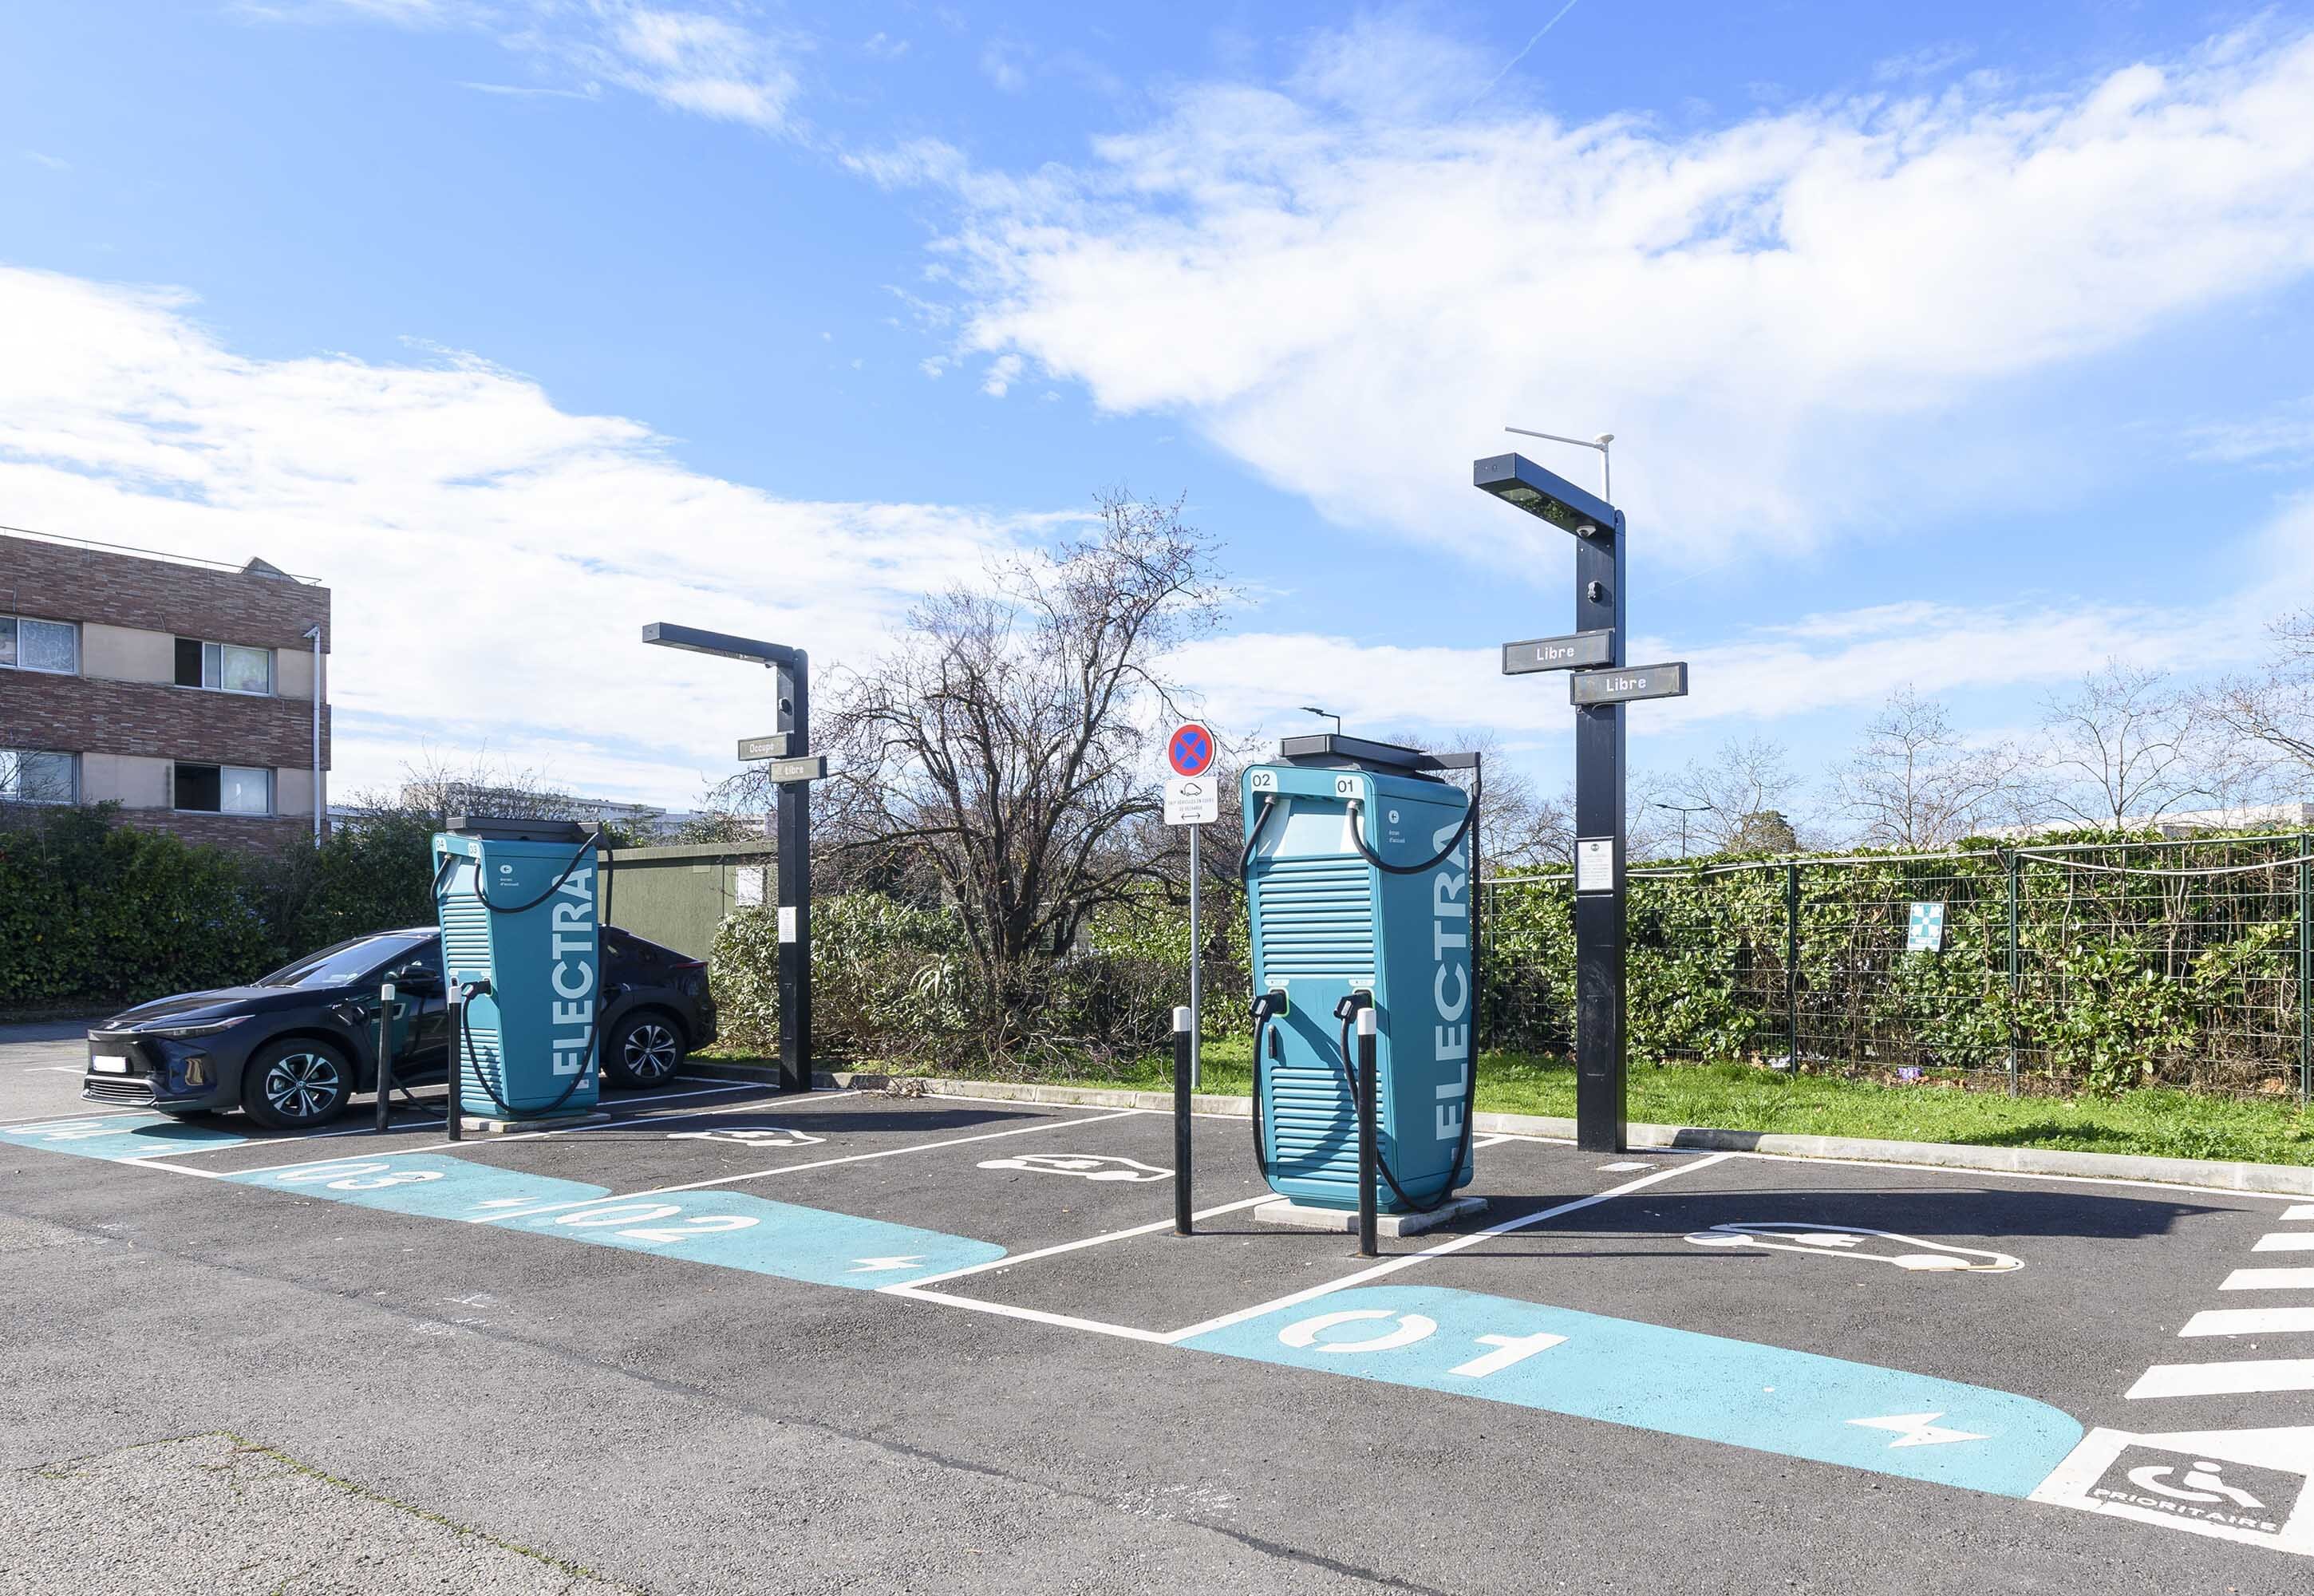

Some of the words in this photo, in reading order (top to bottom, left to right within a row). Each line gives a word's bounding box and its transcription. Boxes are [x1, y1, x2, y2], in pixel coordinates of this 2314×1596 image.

[1536, 647, 1575, 661] Libre
[1605, 678, 1647, 692] Libre
[1252, 773, 1271, 787] 02
[1337, 779, 1354, 793] 01
[551, 867, 594, 1076] ELECTRA
[1433, 819, 1467, 1140] ELECTRA
[276, 1162, 445, 1191] 03
[555, 1203, 761, 1243] 02
[1277, 1309, 1572, 1379] 01
[2092, 1487, 2279, 1532] PRIORITAIRE
